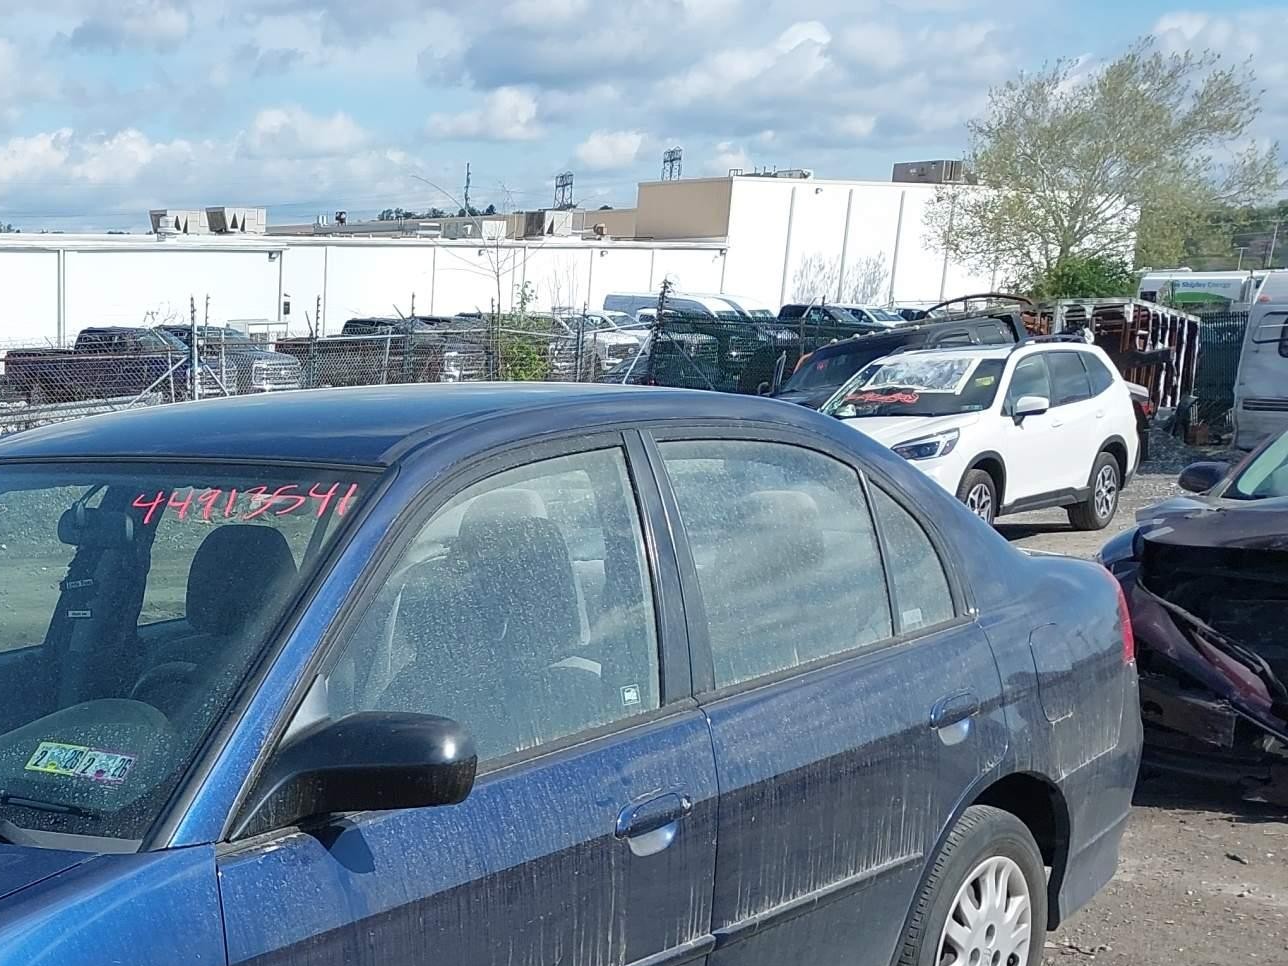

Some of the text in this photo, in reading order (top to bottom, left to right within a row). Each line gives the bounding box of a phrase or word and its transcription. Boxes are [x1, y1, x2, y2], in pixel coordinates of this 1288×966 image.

[132, 481, 359, 525] 44913541
[32, 750, 49, 767] 2
[80, 757, 133, 778] 2 26
